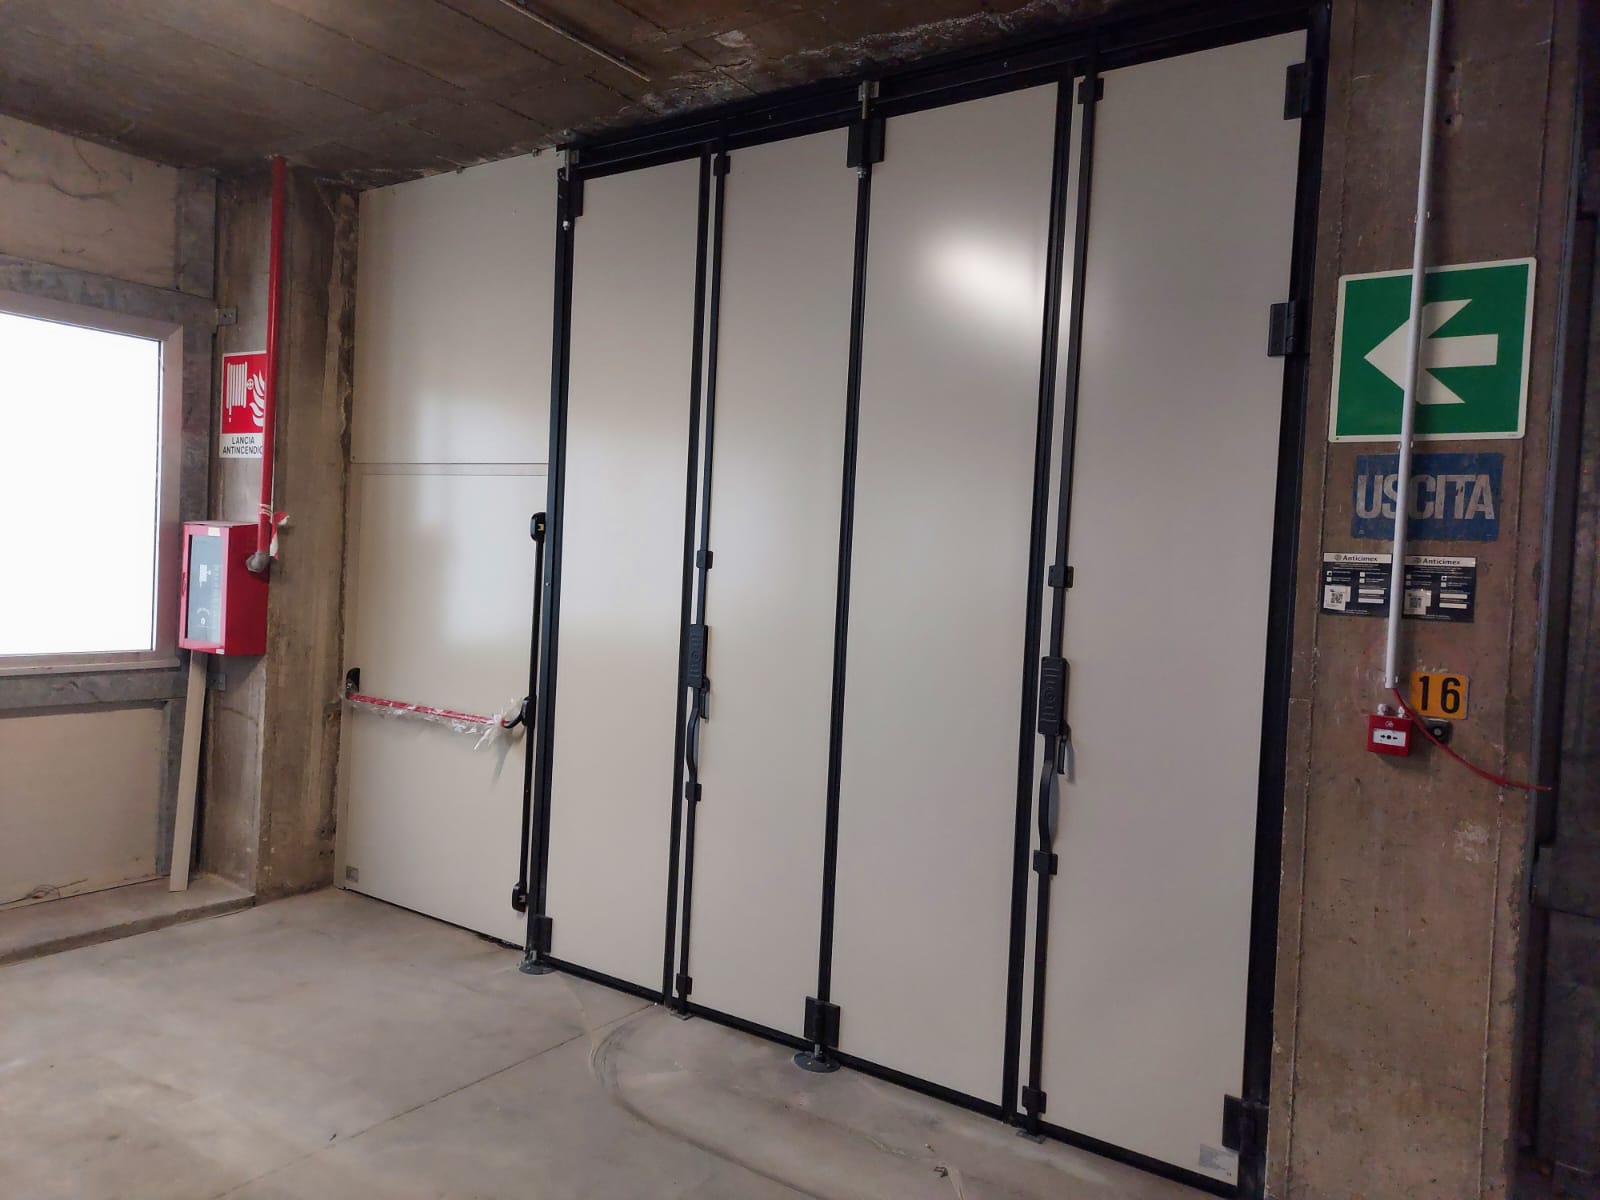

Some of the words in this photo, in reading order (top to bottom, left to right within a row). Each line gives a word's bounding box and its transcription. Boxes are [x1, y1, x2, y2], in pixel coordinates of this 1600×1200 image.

[232, 436, 255, 445] LANCIA
[1356, 474, 1495, 520] USCITA
[1342, 554, 1378, 562] Anticimex
[1422, 558, 1460, 566] Anticimex
[1419, 675, 1461, 714] 16
